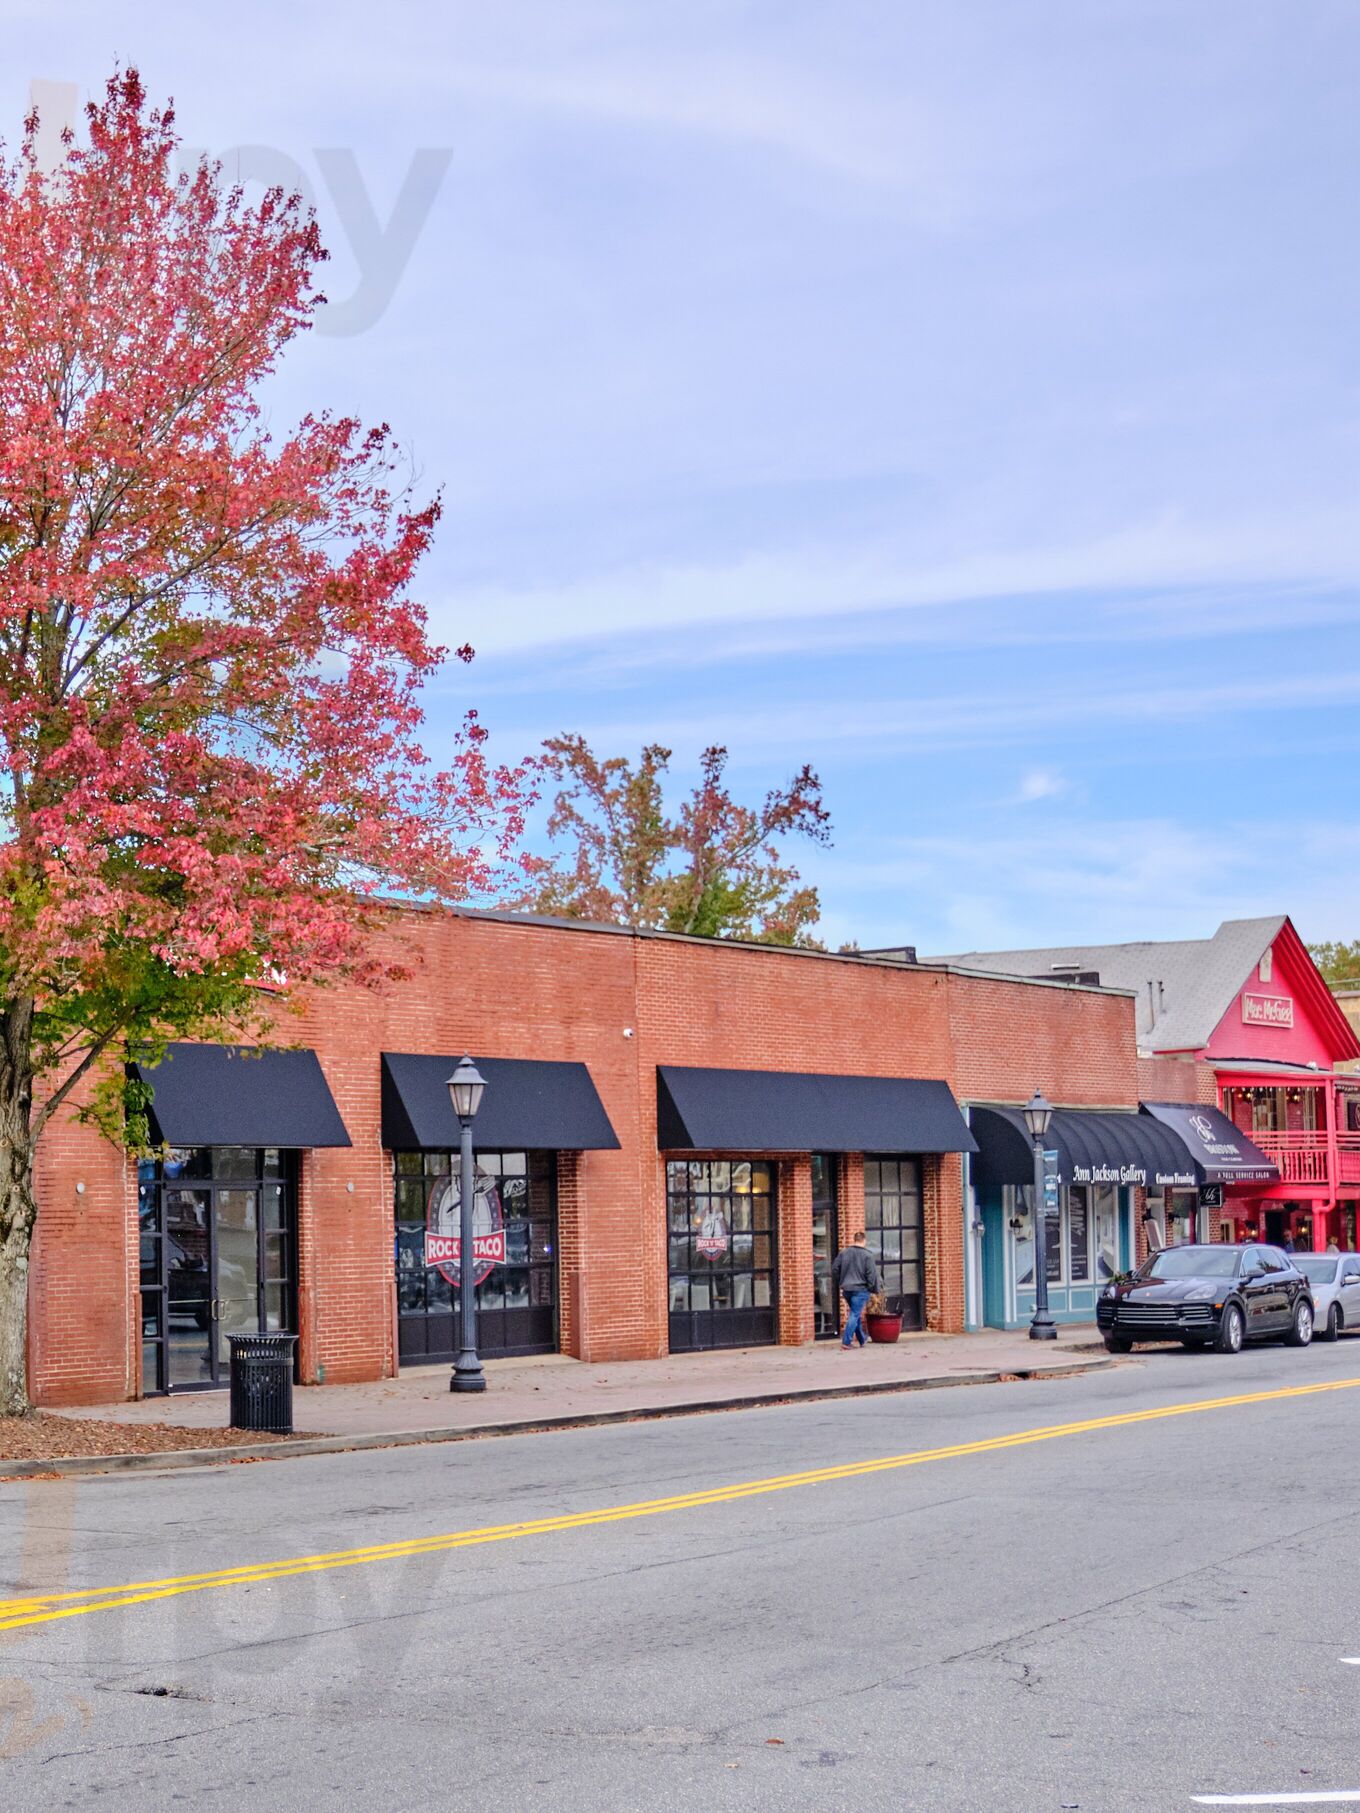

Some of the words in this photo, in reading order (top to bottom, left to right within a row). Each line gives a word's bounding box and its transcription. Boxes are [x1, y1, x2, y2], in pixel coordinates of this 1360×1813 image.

[1073, 1165, 1090, 1182] Ann
[1090, 1164, 1120, 1184] Jackson
[1120, 1164, 1146, 1186] Gallery
[428, 1239, 459, 1259] ROCK
[473, 1237, 501, 1256] TACO
